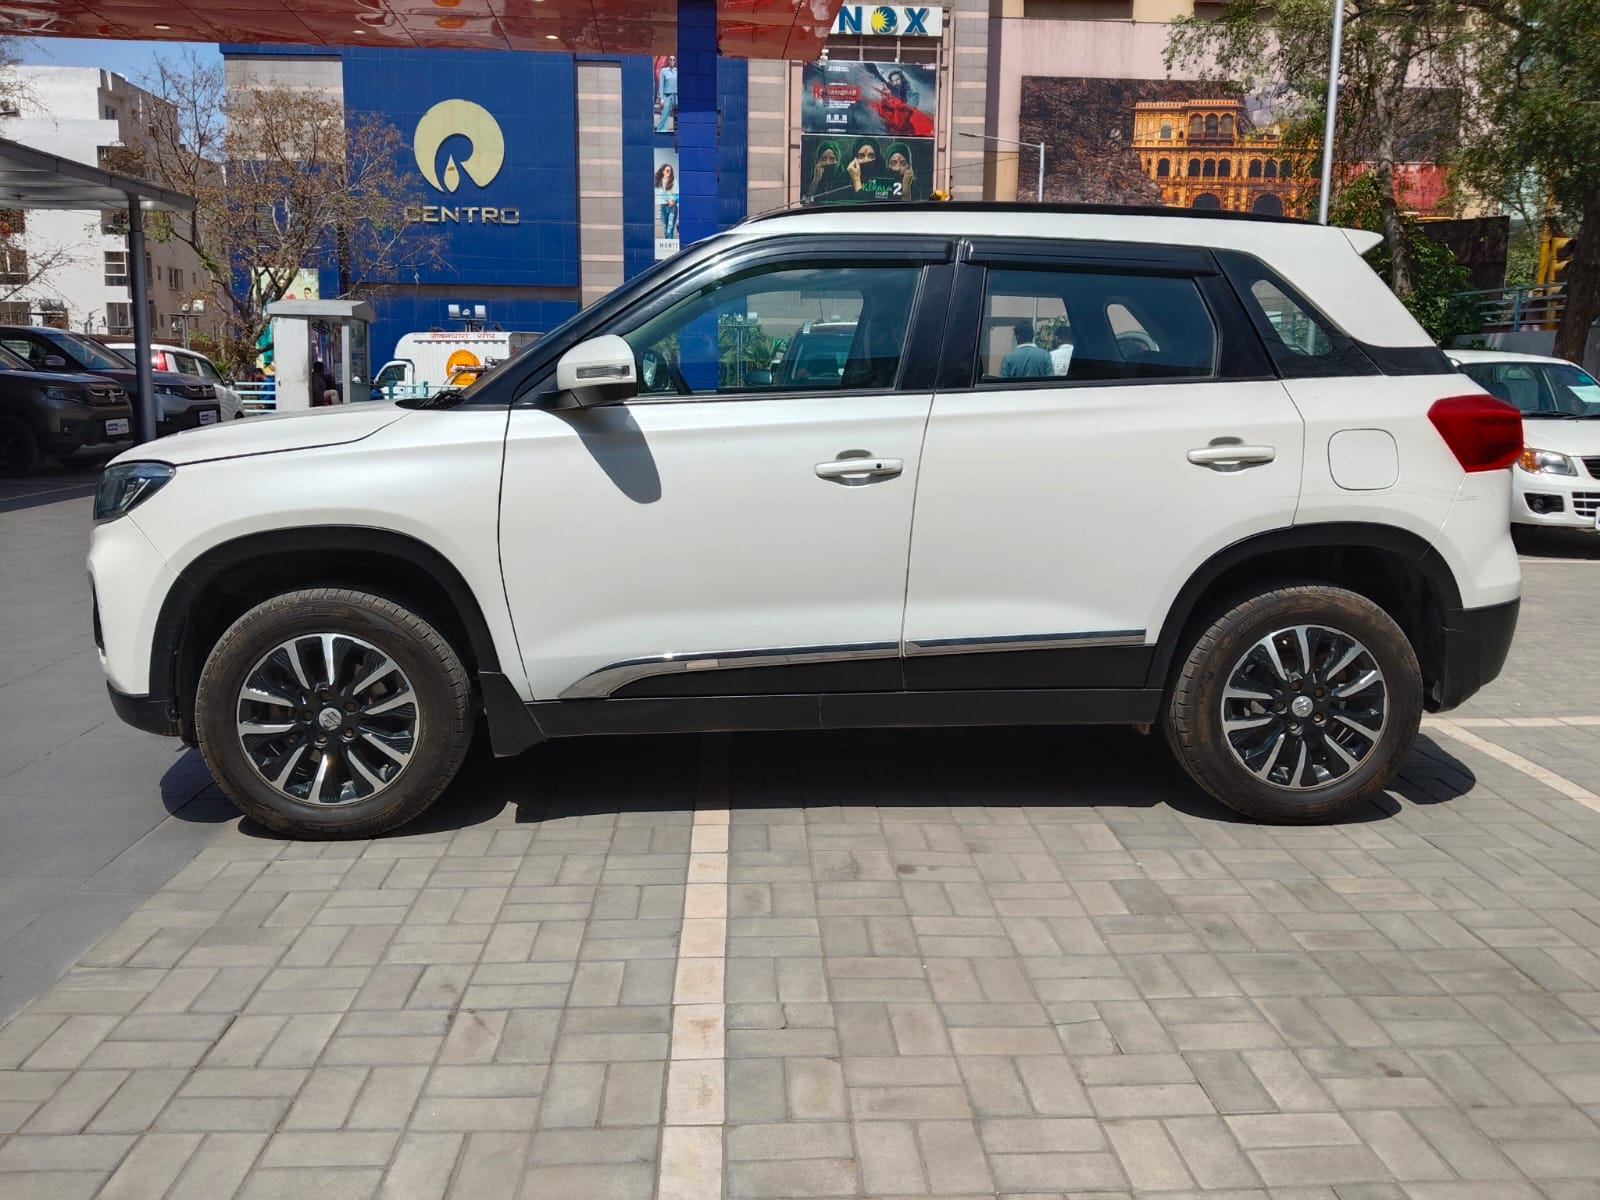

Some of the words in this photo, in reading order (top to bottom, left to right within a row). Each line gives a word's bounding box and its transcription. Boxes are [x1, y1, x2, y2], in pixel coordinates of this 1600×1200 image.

[838, 6, 930, 35] NOX
[893, 182, 903, 196] 2
[403, 206, 520, 224] CENTRO
